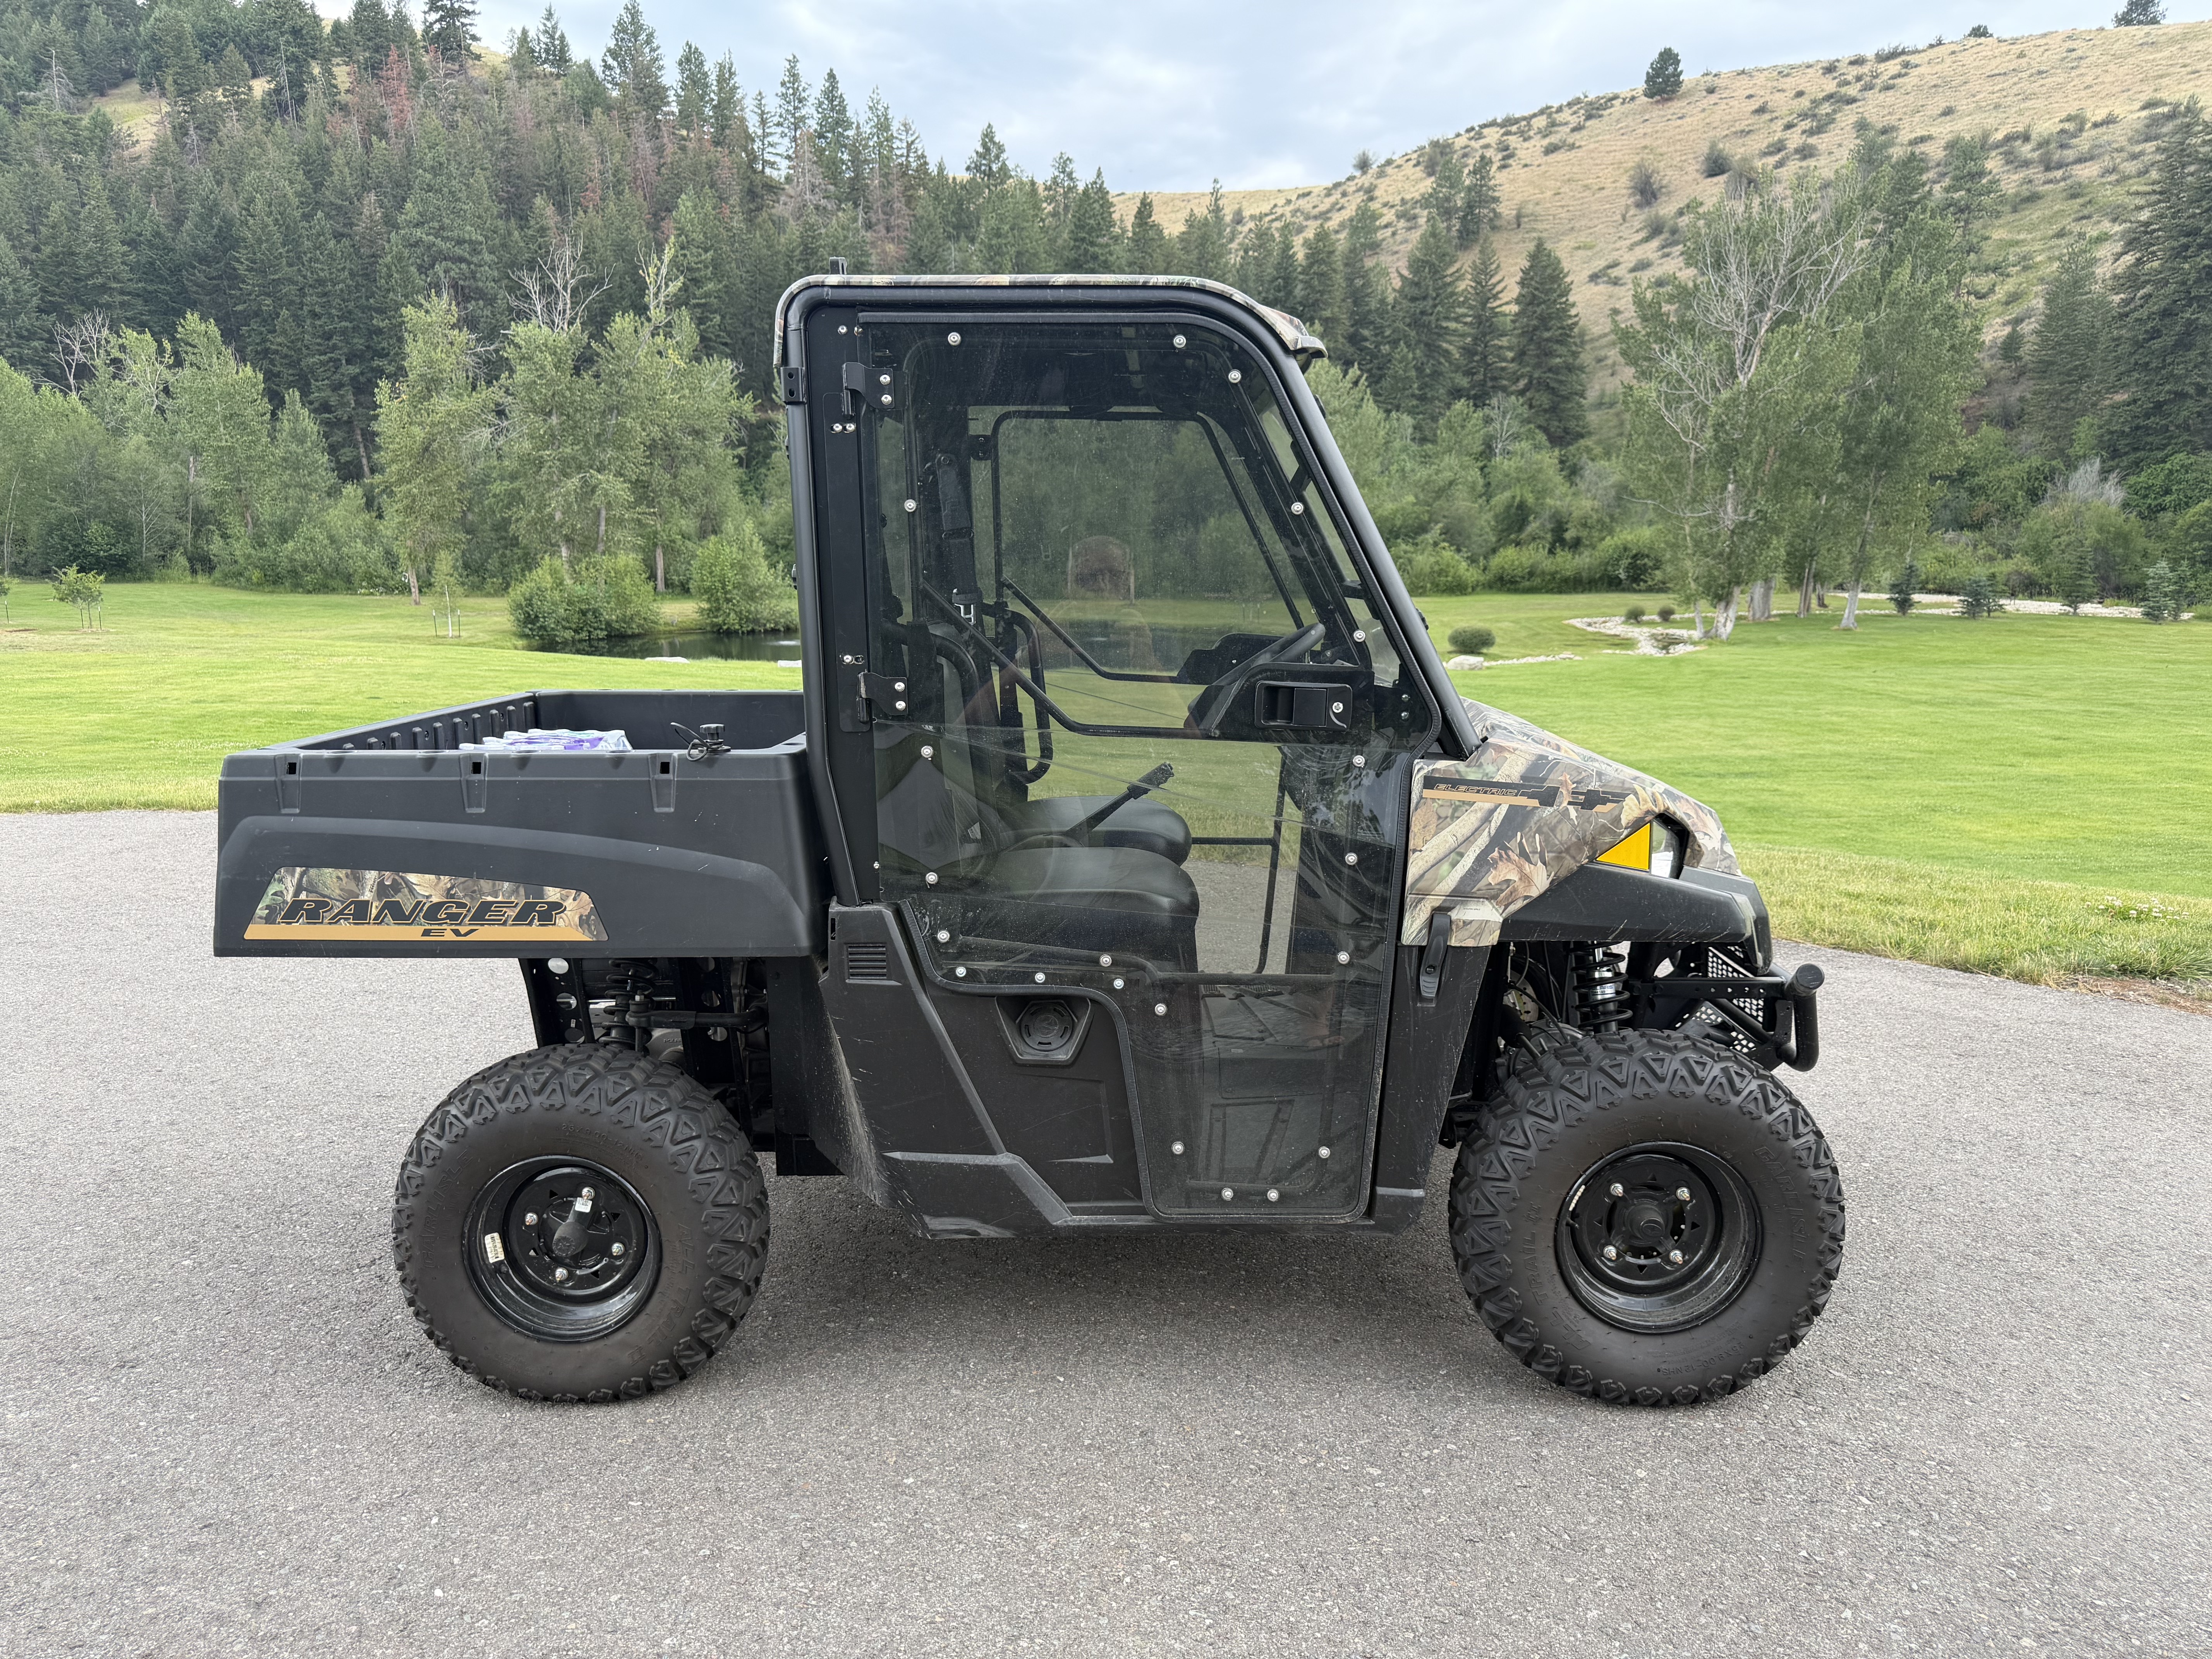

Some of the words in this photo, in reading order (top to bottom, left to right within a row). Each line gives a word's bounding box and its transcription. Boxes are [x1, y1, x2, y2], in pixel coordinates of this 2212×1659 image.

[1434, 783, 1517, 795] ELECTRIC
[277, 898, 566, 925] RANGER
[421, 928, 479, 937] EV
[421, 1150, 473, 1268] CARLISLE
[1753, 1146, 1809, 1267] CARLISLE
[677, 1223, 695, 1274] ALL
[1522, 1231, 1548, 1305] TRAIL
[647, 1286, 690, 1346] TRAIL
[1550, 1310, 1591, 1350] ALL
